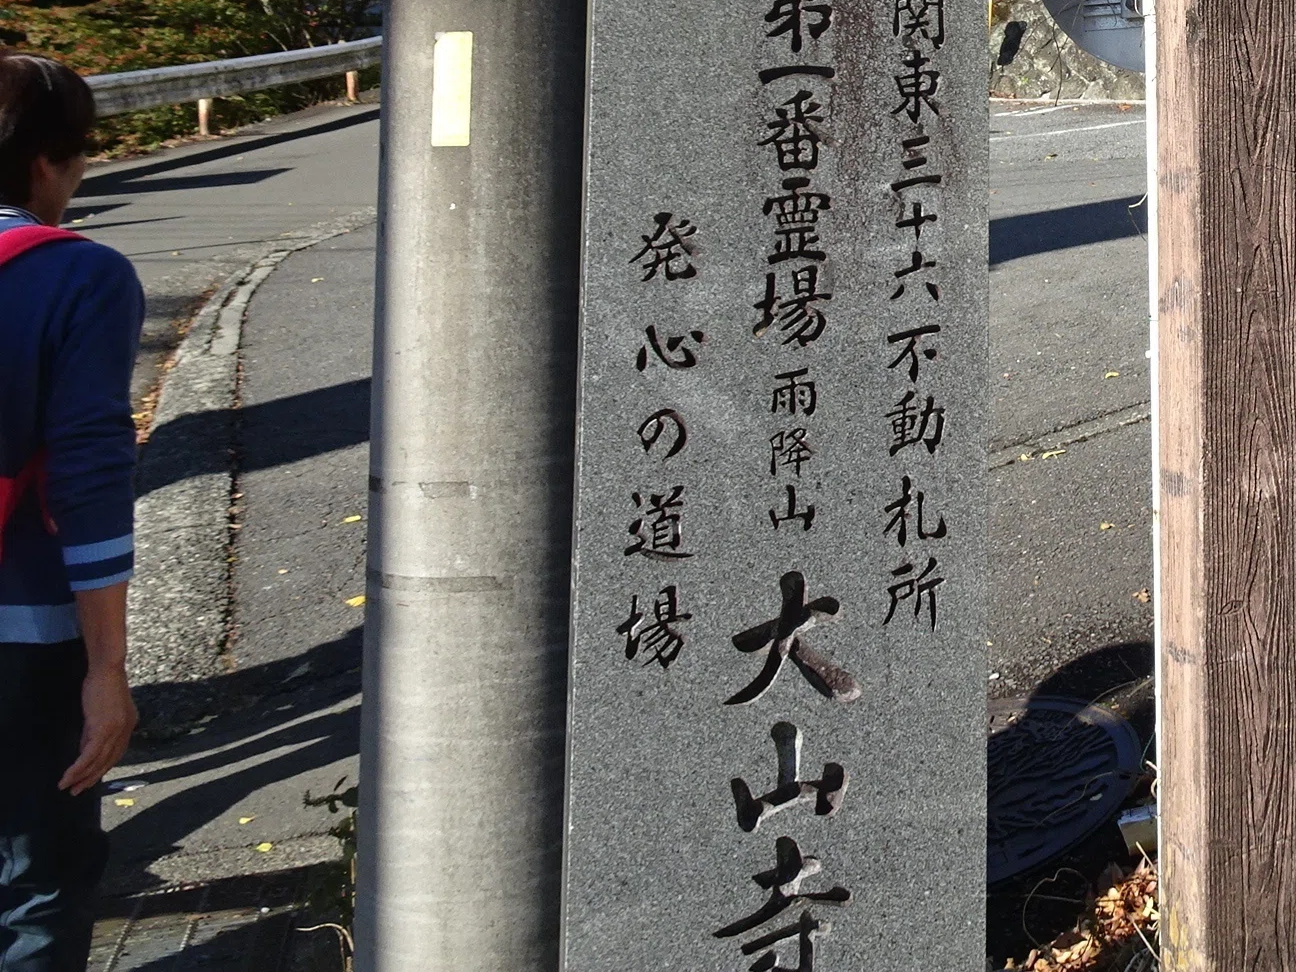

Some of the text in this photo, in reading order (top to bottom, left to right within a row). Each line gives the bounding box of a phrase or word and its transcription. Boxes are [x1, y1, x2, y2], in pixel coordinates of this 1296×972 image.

[616, 212, 704, 668] 発心の道場
[769, 368, 818, 531] 雨降山
